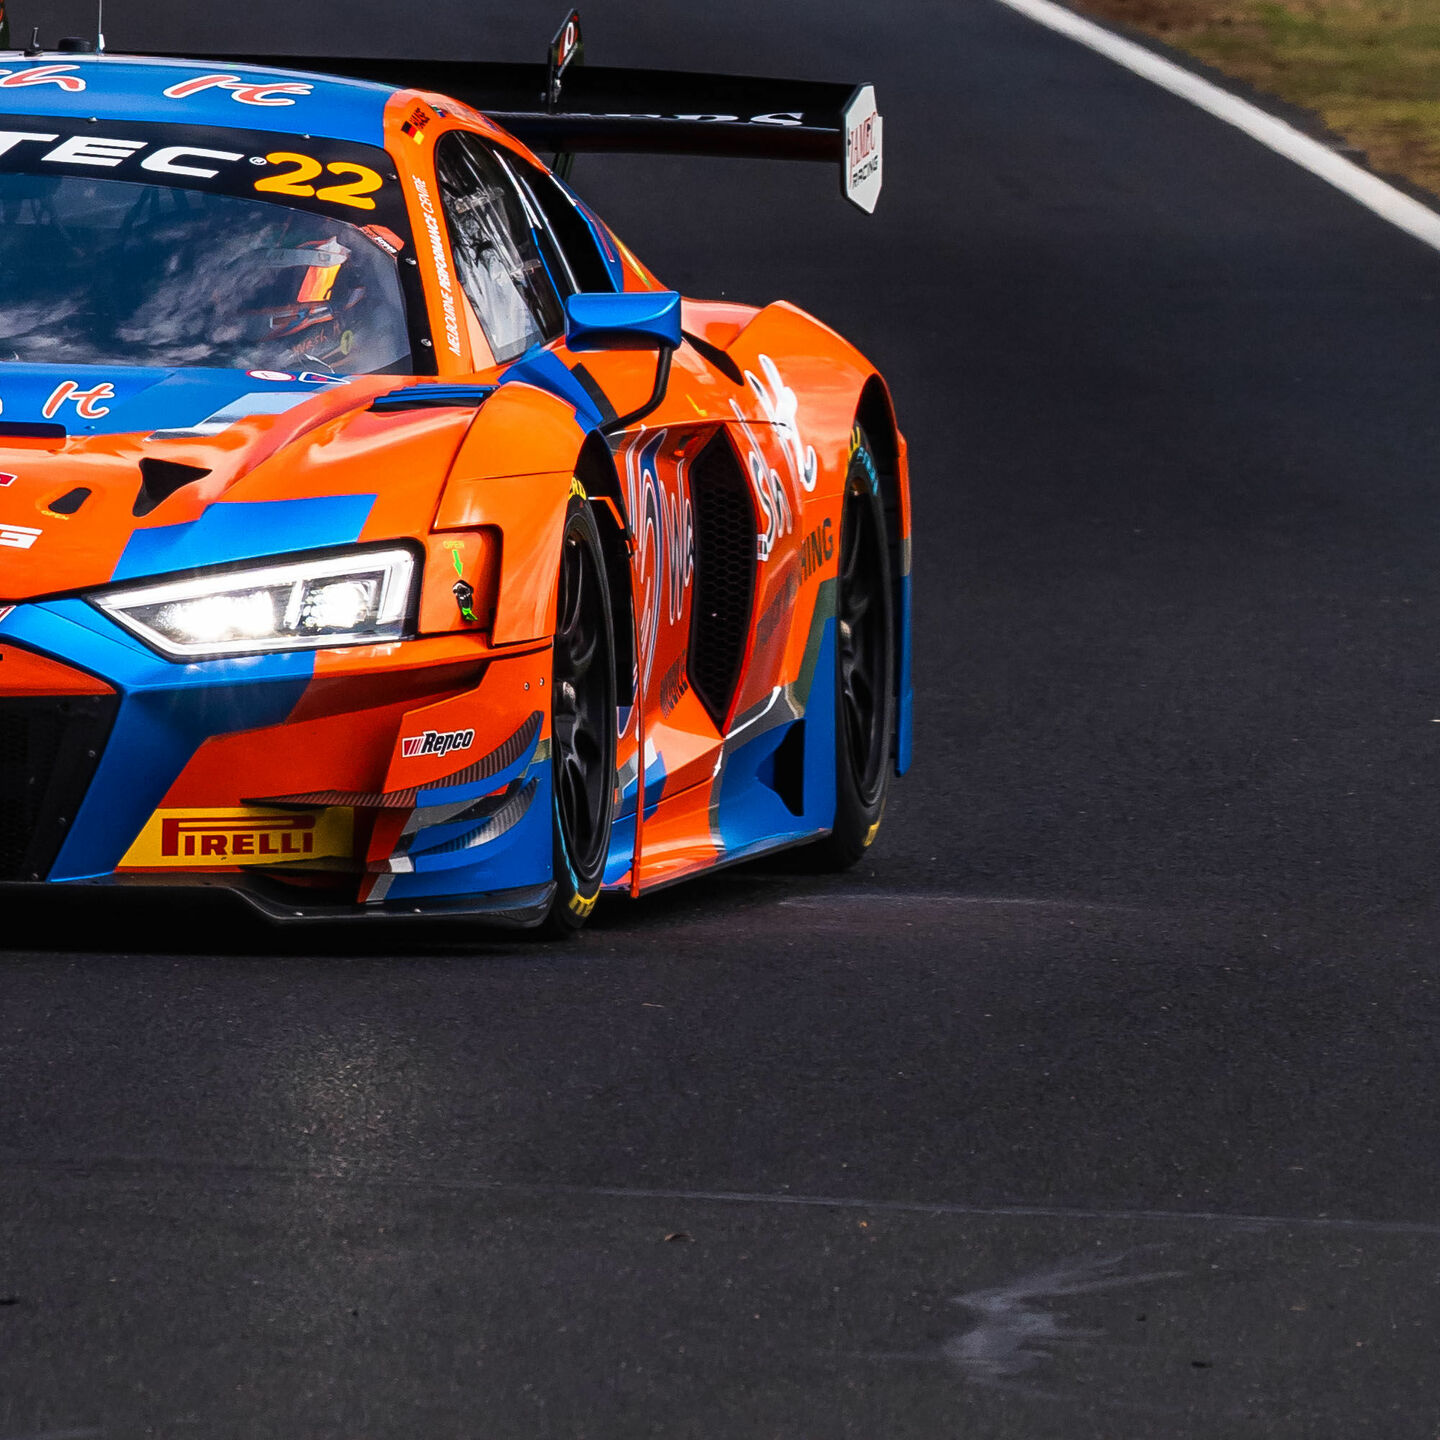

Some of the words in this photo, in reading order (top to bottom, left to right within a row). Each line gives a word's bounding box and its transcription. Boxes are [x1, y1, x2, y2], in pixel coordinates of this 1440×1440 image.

[163, 73, 314, 107] It
[253, 151, 384, 210] 22
[42, 380, 115, 418] It
[420, 730, 474, 756] Repco
[161, 815, 315, 856] PIRELLI
